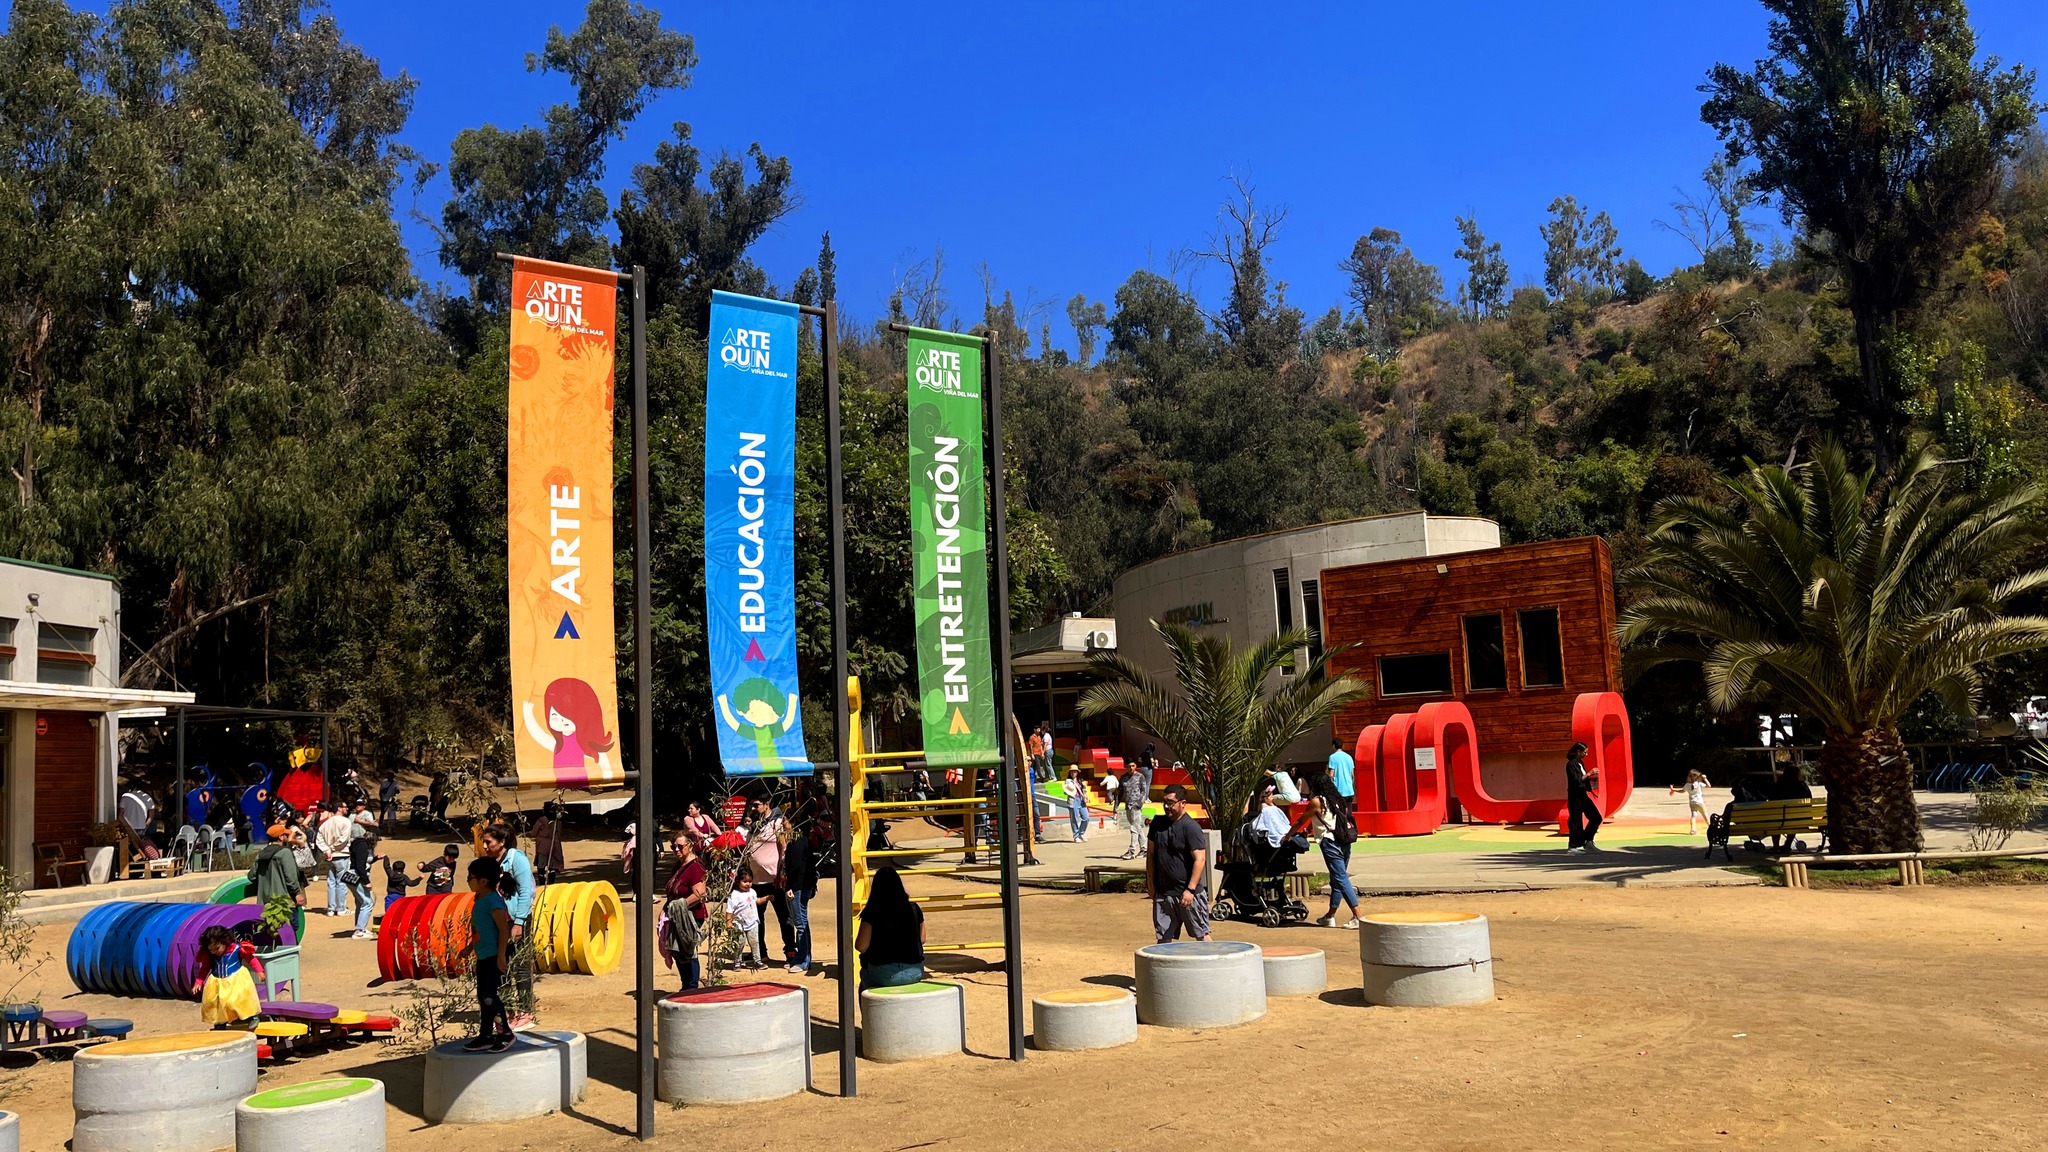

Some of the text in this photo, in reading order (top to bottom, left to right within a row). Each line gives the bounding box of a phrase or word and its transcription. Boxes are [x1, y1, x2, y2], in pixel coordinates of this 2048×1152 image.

[526, 280, 582, 305] ARTE
[525, 299, 582, 328] QUIN
[560, 324, 576, 332] VIÑA
[589, 328, 604, 336] MAR
[721, 327, 770, 350] ARTE
[721, 345, 770, 371] QUIN
[915, 348, 960, 370] ARTE
[915, 366, 961, 393] QUIN
[730, 431, 766, 632] EDUCACIÓN
[550, 484, 581, 606] ARTE
[926, 436, 969, 702] ENTRETENCIÓN
